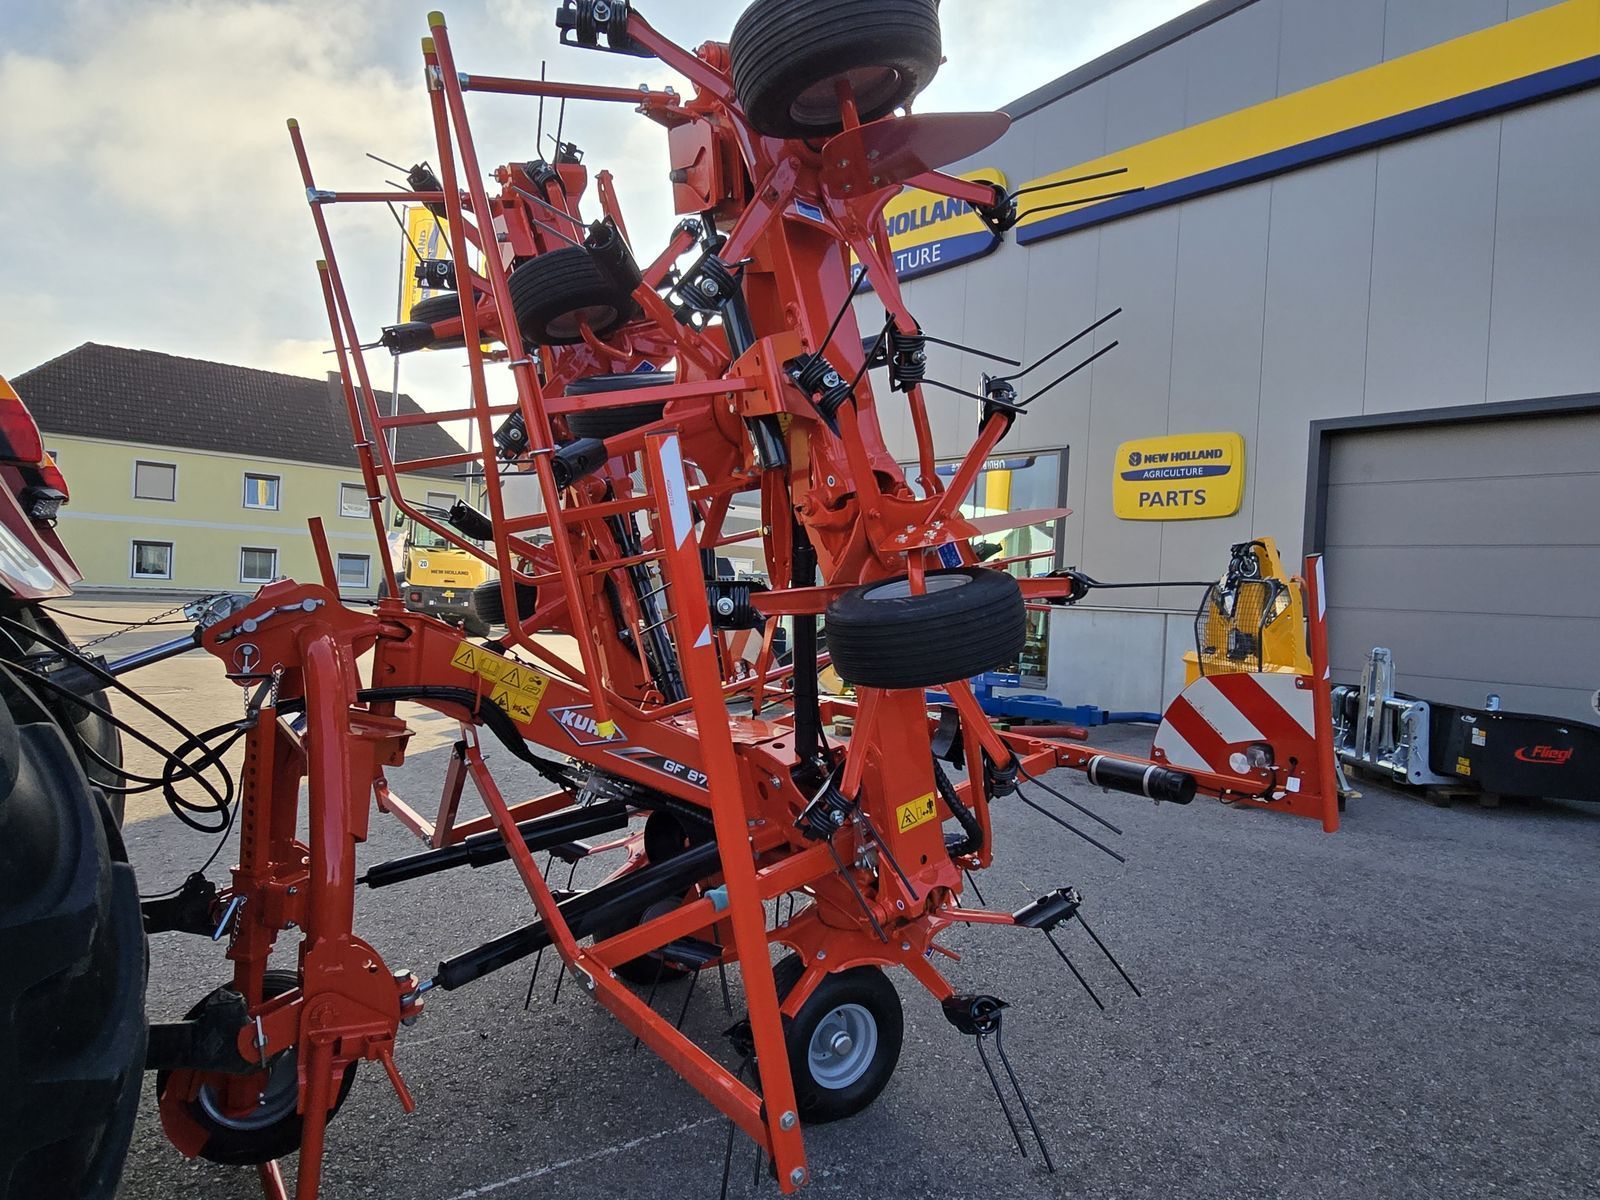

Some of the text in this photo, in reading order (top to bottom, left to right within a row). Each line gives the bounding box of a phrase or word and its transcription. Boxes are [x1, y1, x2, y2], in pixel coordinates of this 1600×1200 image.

[1144, 448, 1223, 464] NEW HOLLAND
[1143, 467, 1203, 479] AGRICULTURE
[1139, 489, 1206, 507] PARTS
[1532, 745, 1574, 762] Fliegl
[663, 759, 709, 786] GF 87
